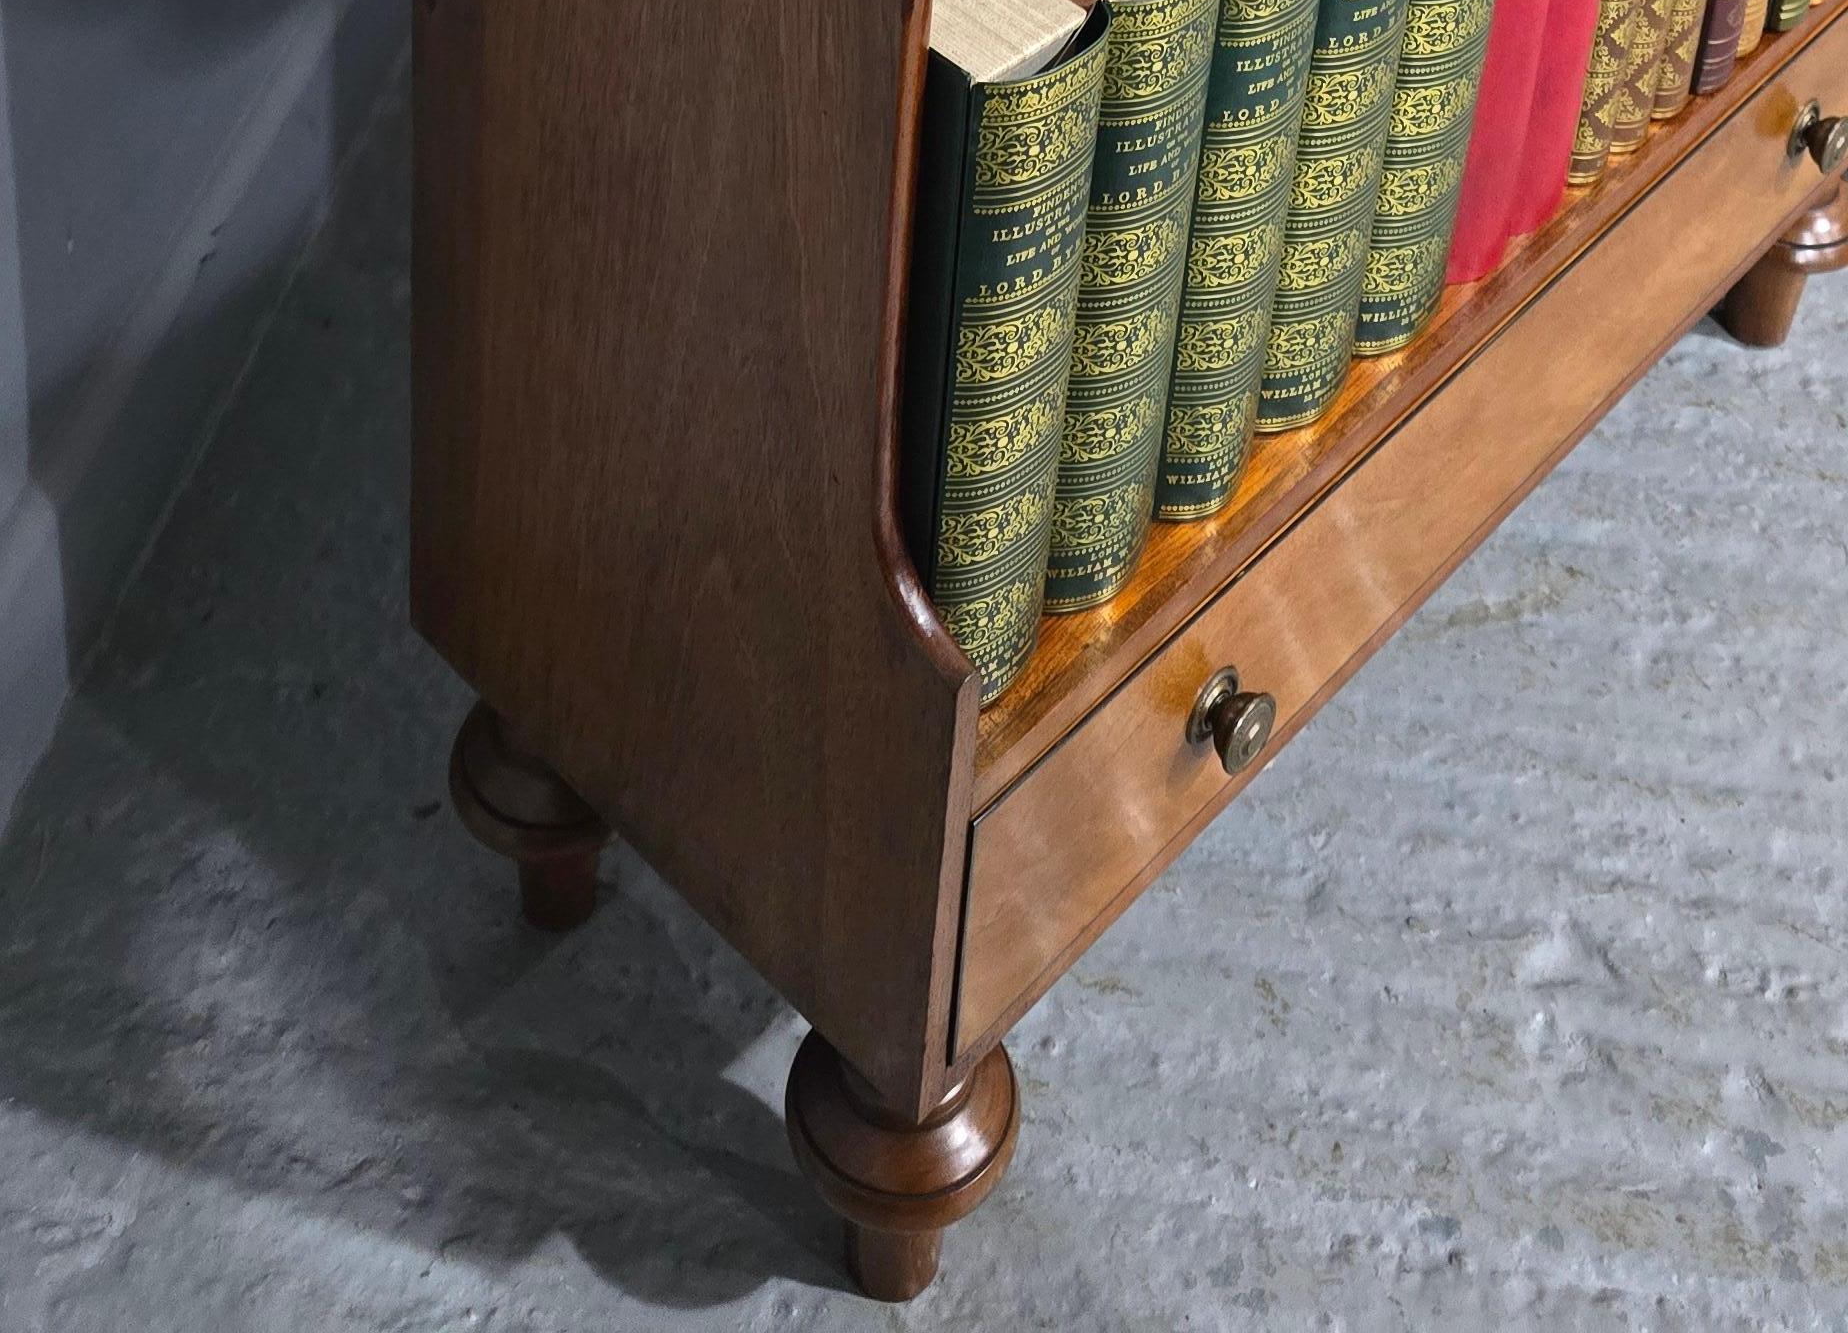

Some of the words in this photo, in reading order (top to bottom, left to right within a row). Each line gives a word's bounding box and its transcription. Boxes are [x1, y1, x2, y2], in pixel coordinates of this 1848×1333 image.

[1353, 6, 1378, 22] LIFE
[1328, 26, 1383, 50] LORD
[1247, 77, 1275, 95] LIFE
[1222, 97, 1281, 123] LORD
[1128, 158, 1159, 176] LIFE
[1160, 146, 1181, 167] AND
[1102, 179, 1163, 205] LORD
[1006, 246, 1037, 267] LIFE
[1039, 232, 1062, 254] AND
[979, 268, 1043, 296] LORD
[1261, 378, 1321, 400] WILLIAM
[1166, 463, 1230, 486] WILLIAM
[1047, 555, 1113, 580] WILLIAM
